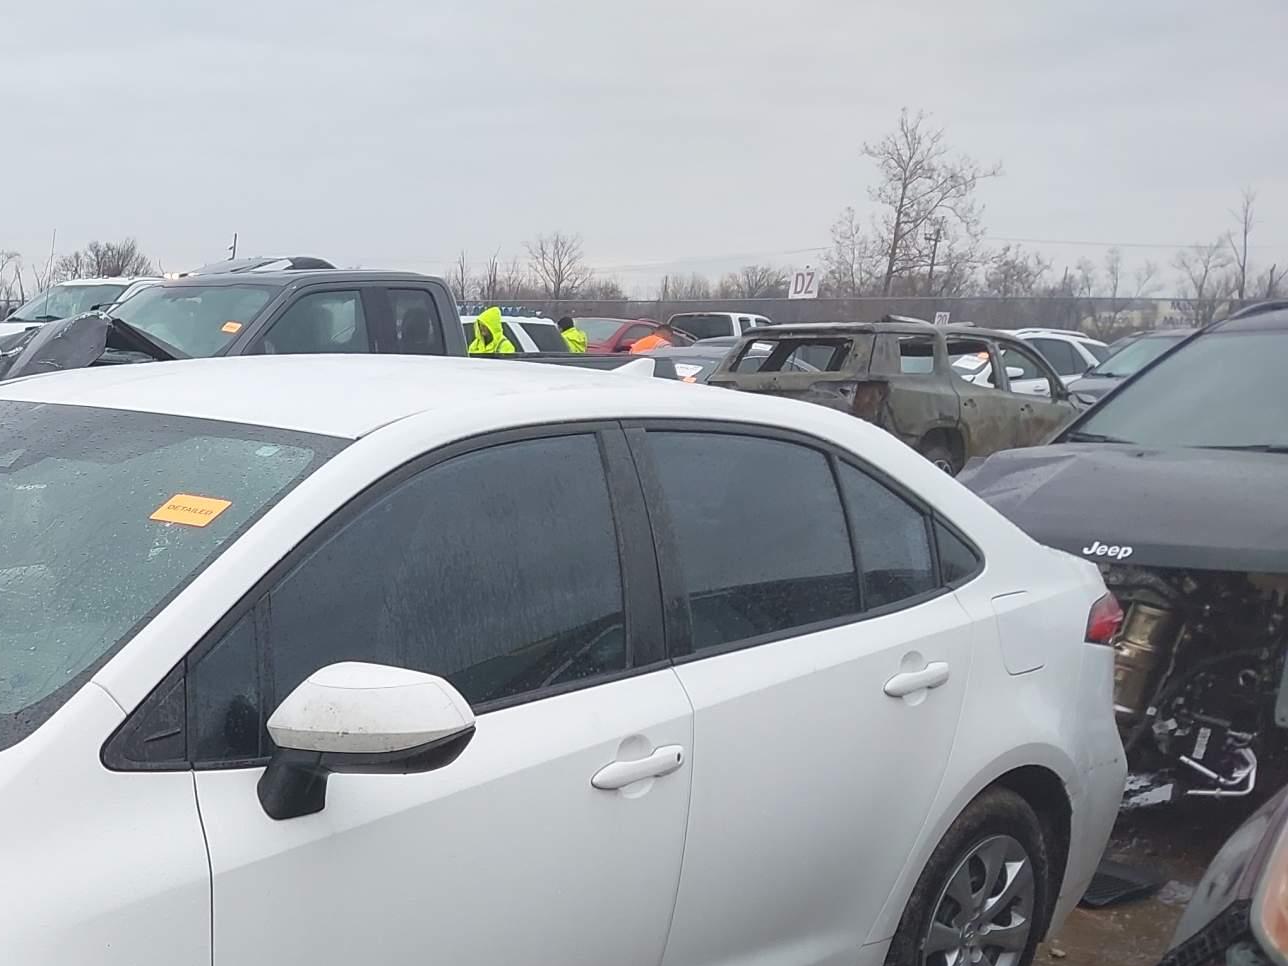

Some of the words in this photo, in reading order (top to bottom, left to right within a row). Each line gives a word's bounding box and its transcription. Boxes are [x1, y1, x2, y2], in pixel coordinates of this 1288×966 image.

[793, 271, 815, 295] DZ
[167, 504, 214, 516] DETAILED
[1082, 541, 1133, 560] Jeep
